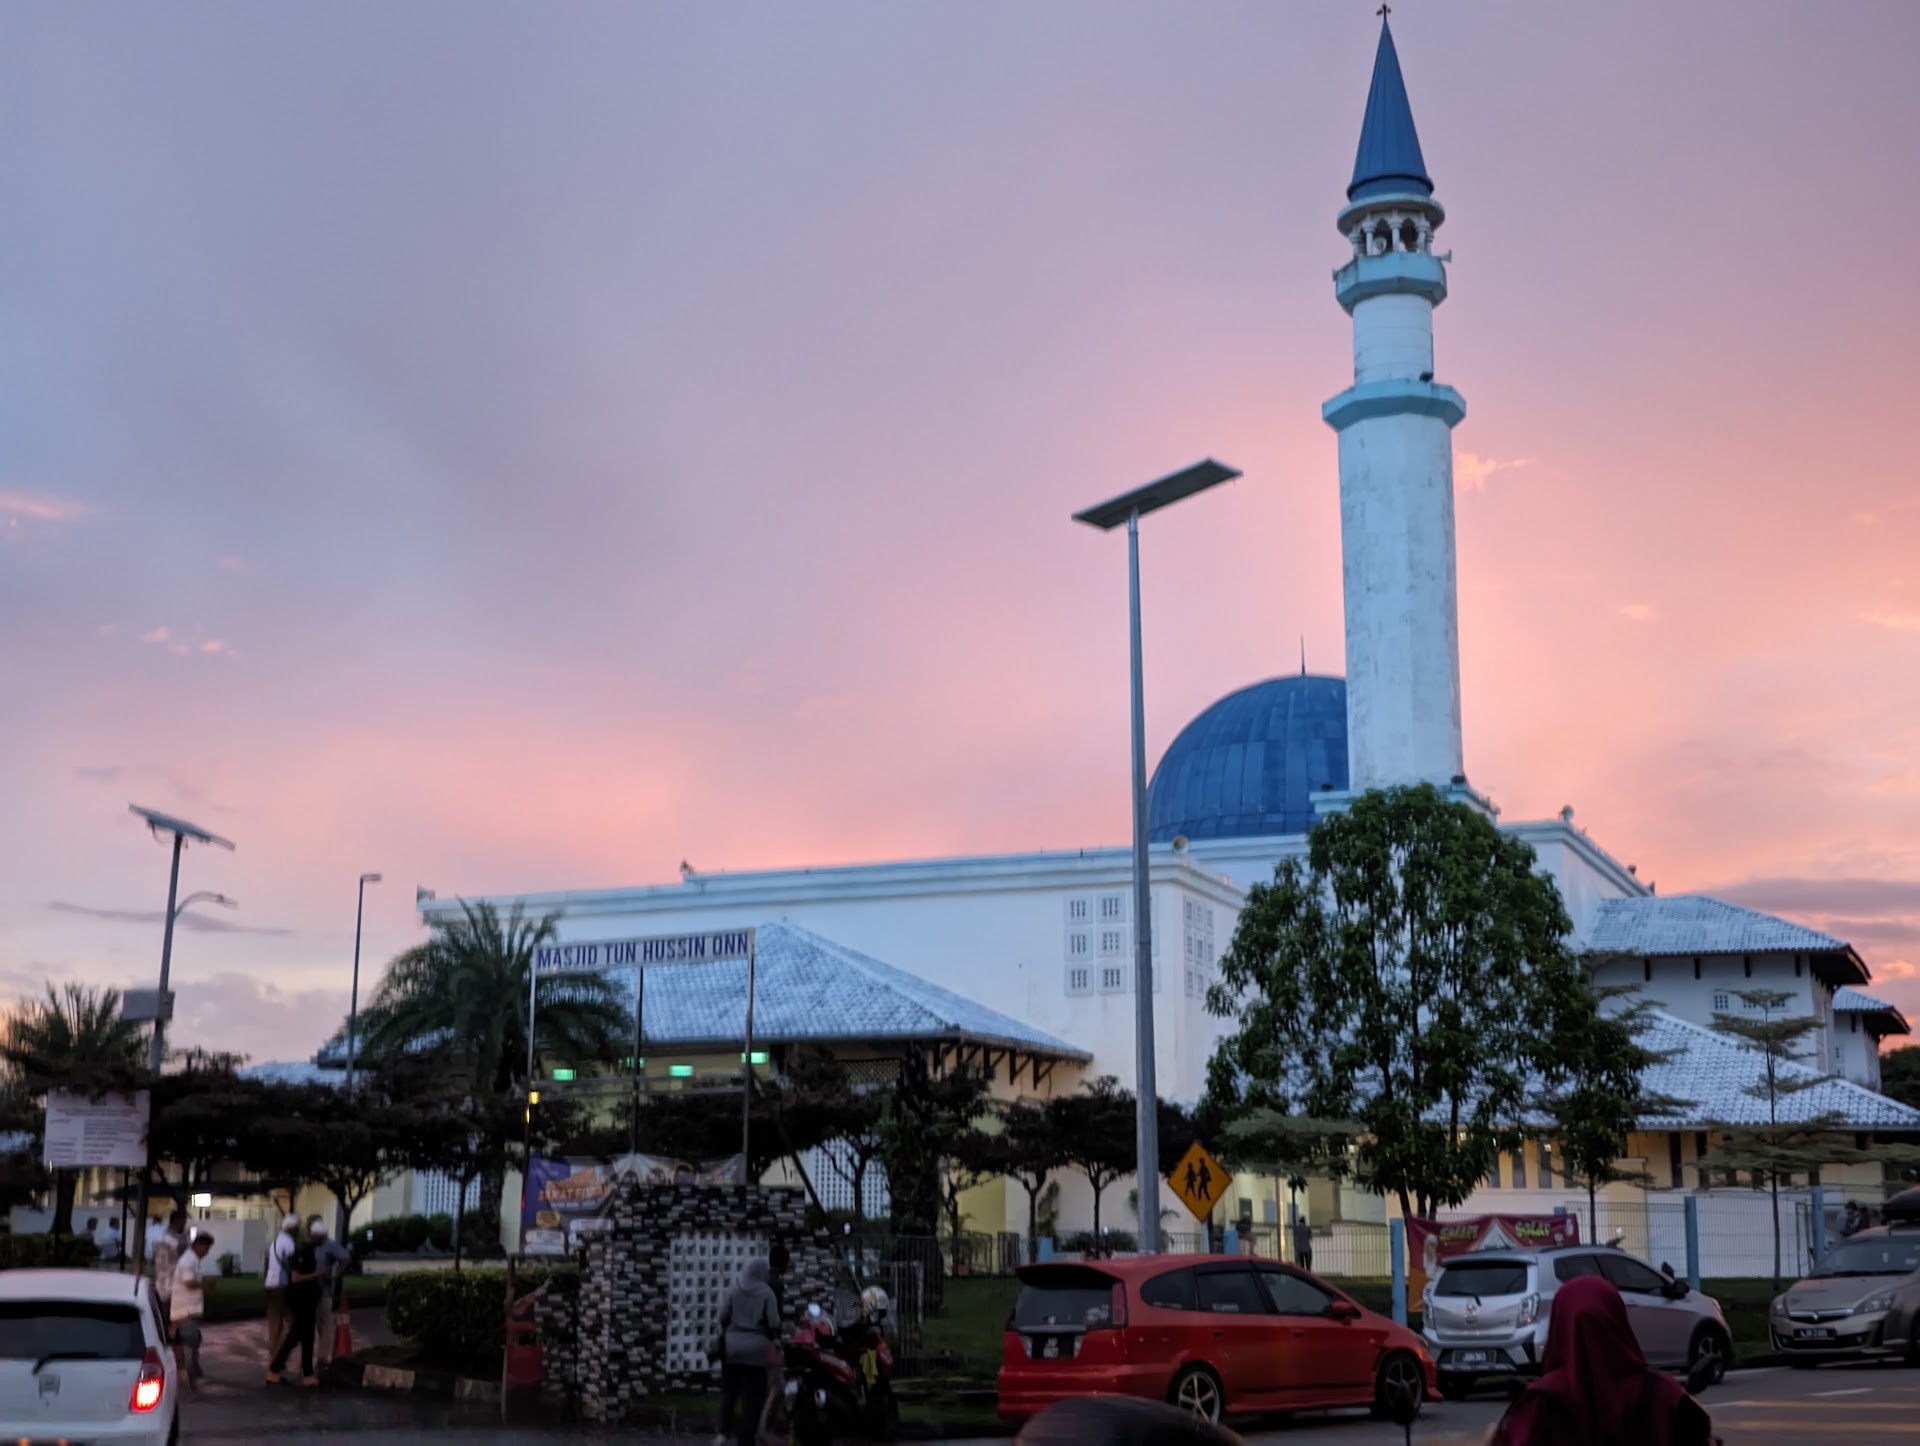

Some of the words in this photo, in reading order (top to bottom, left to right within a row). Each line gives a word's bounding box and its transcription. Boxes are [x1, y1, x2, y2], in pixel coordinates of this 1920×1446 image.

[537, 945, 598, 968] MASJID
[604, 942, 636, 964] TUN
[643, 937, 705, 961] HUSSIN
[712, 933, 748, 955] ONN
